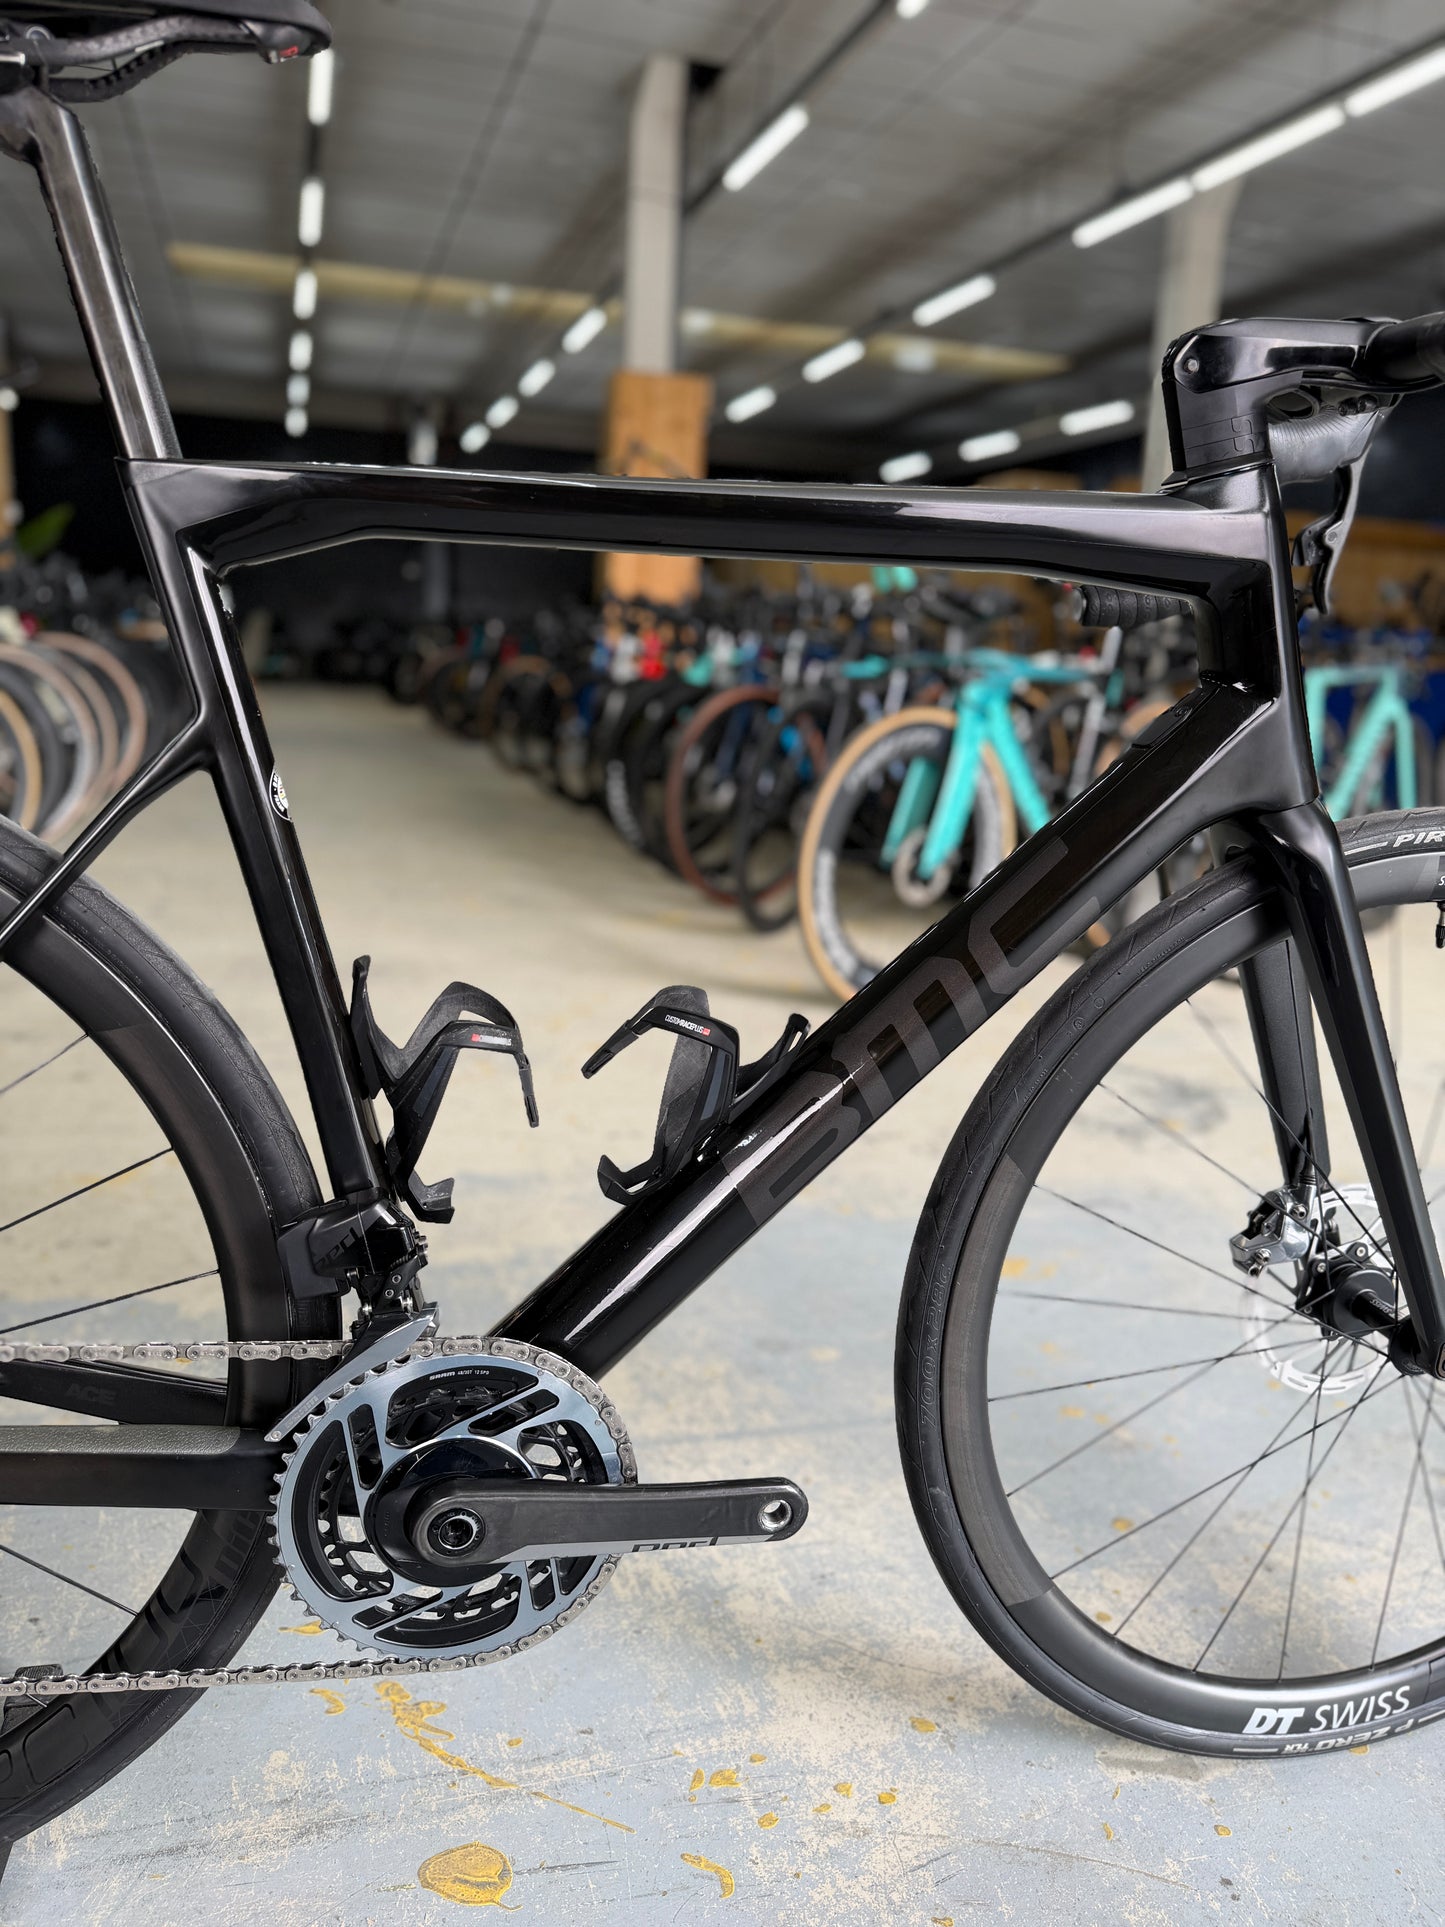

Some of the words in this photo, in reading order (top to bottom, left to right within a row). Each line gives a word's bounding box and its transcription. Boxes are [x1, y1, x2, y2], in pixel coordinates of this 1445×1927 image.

[720, 836, 1101, 1227] BMC
[1242, 1707, 1306, 1735] DT
[1308, 1685, 1411, 1733] SWISS
[1313, 1725, 1391, 1751] ZERO
